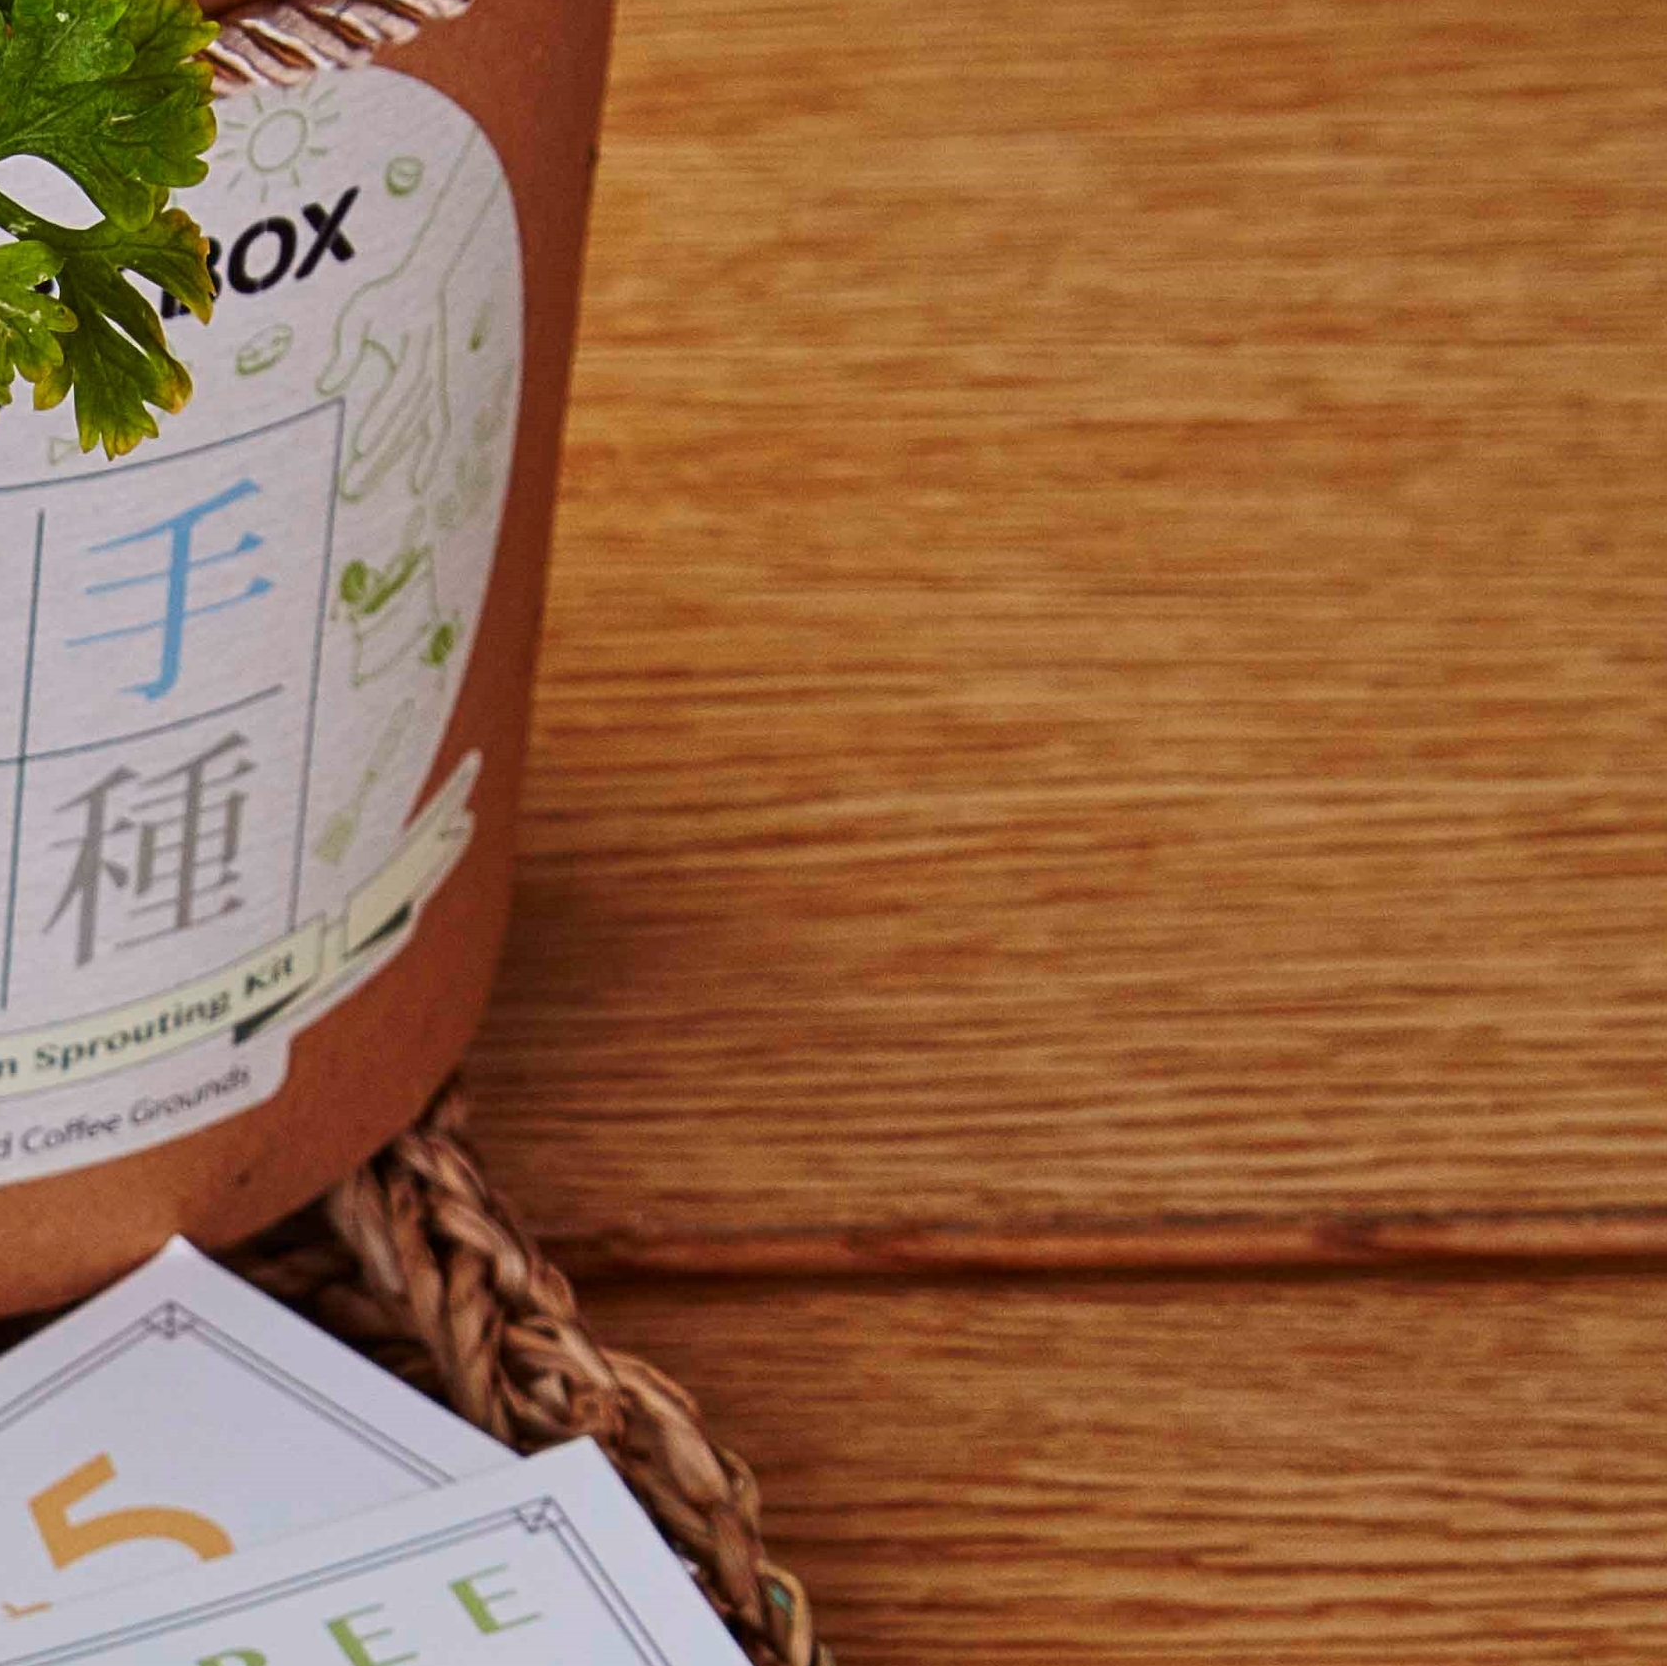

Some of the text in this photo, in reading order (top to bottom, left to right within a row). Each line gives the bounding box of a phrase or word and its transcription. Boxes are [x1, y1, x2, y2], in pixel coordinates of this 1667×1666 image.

[34, 989, 232, 1072] Sprouting
[242, 952, 296, 1000] Kit
[21, 1111, 123, 1156] Coffee
[129, 1065, 251, 1128] Grounds
